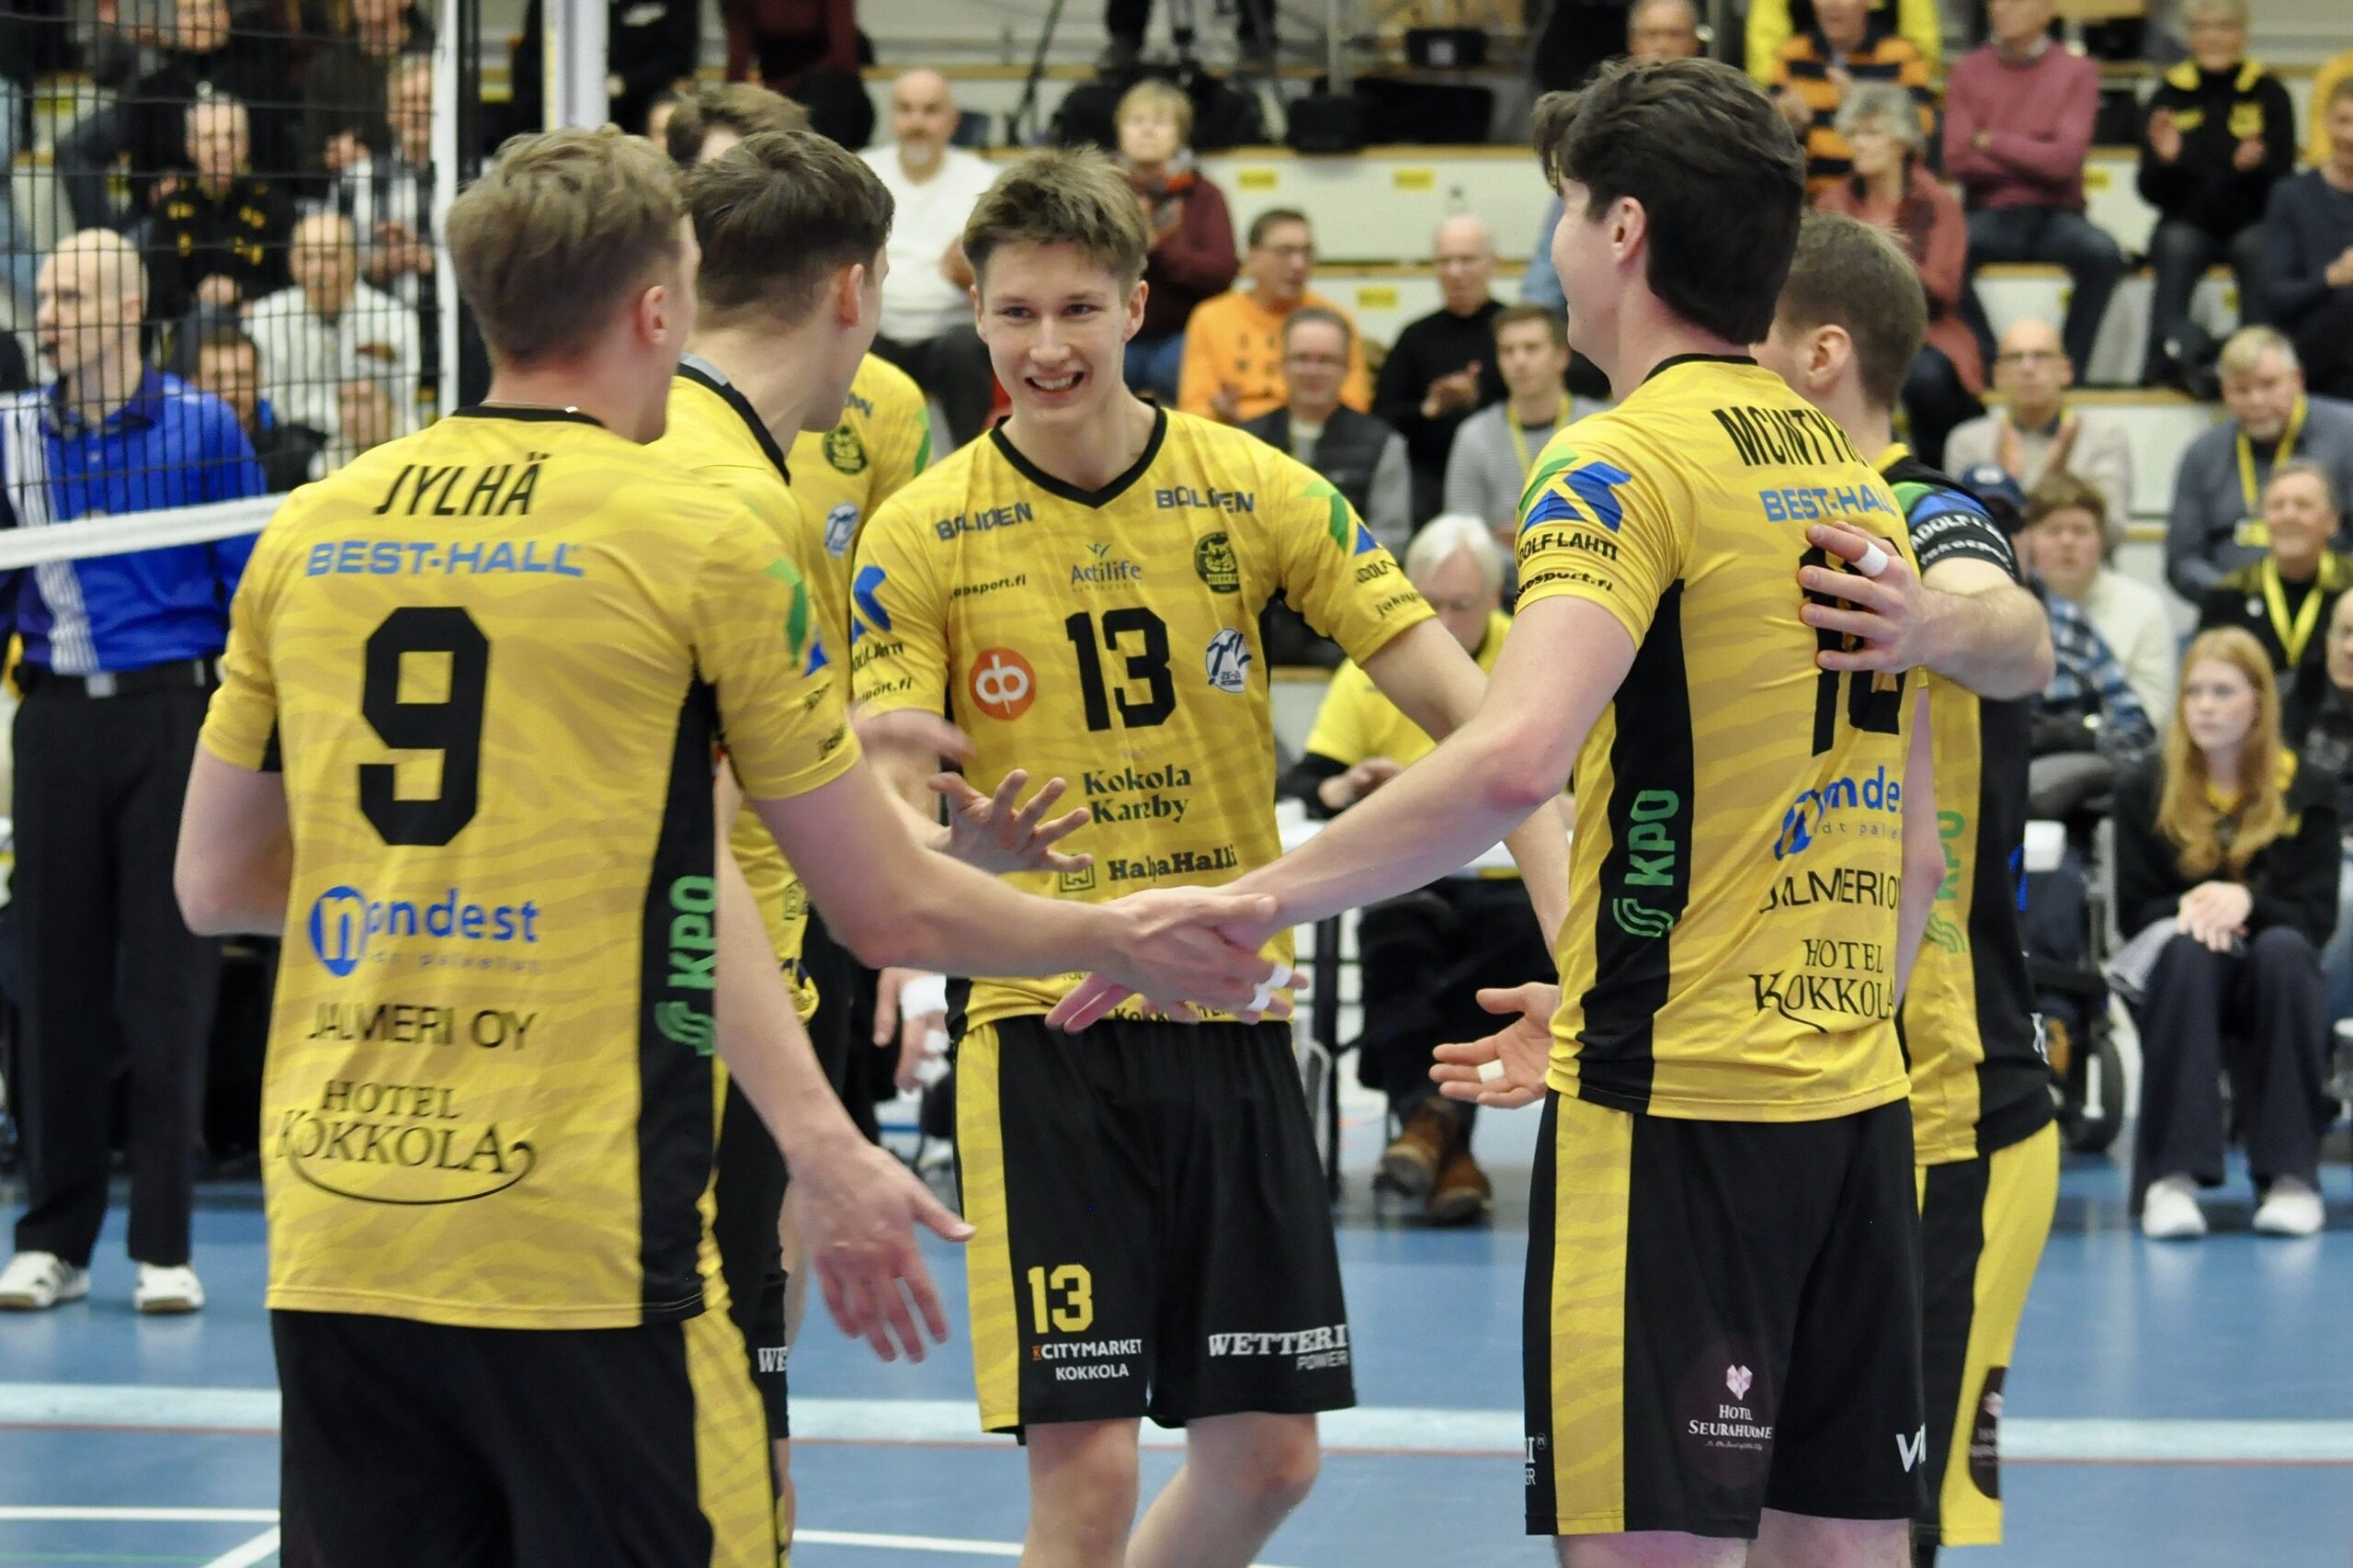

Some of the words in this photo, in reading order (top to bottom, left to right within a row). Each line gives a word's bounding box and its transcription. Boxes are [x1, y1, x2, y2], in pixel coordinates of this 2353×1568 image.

[371, 452, 549, 517] JYLHÄ
[1071, 558, 1143, 585] Actilife
[1063, 606, 1178, 733] 13
[357, 606, 491, 847] 9
[1624, 789, 1680, 887] KPO
[666, 875, 716, 990] KPO
[1802, 938, 1883, 973] HOTEL
[1748, 971, 1896, 1020] KOKKOLA
[471, 1008, 540, 1051] OY
[319, 1079, 463, 1119] HOTEL
[276, 1108, 515, 1176] KOKKOLA
[1028, 1263, 1094, 1335] 13
[1207, 1324, 1348, 1358] WETTERI
[1055, 1363, 1130, 1381] KOKKOLA
